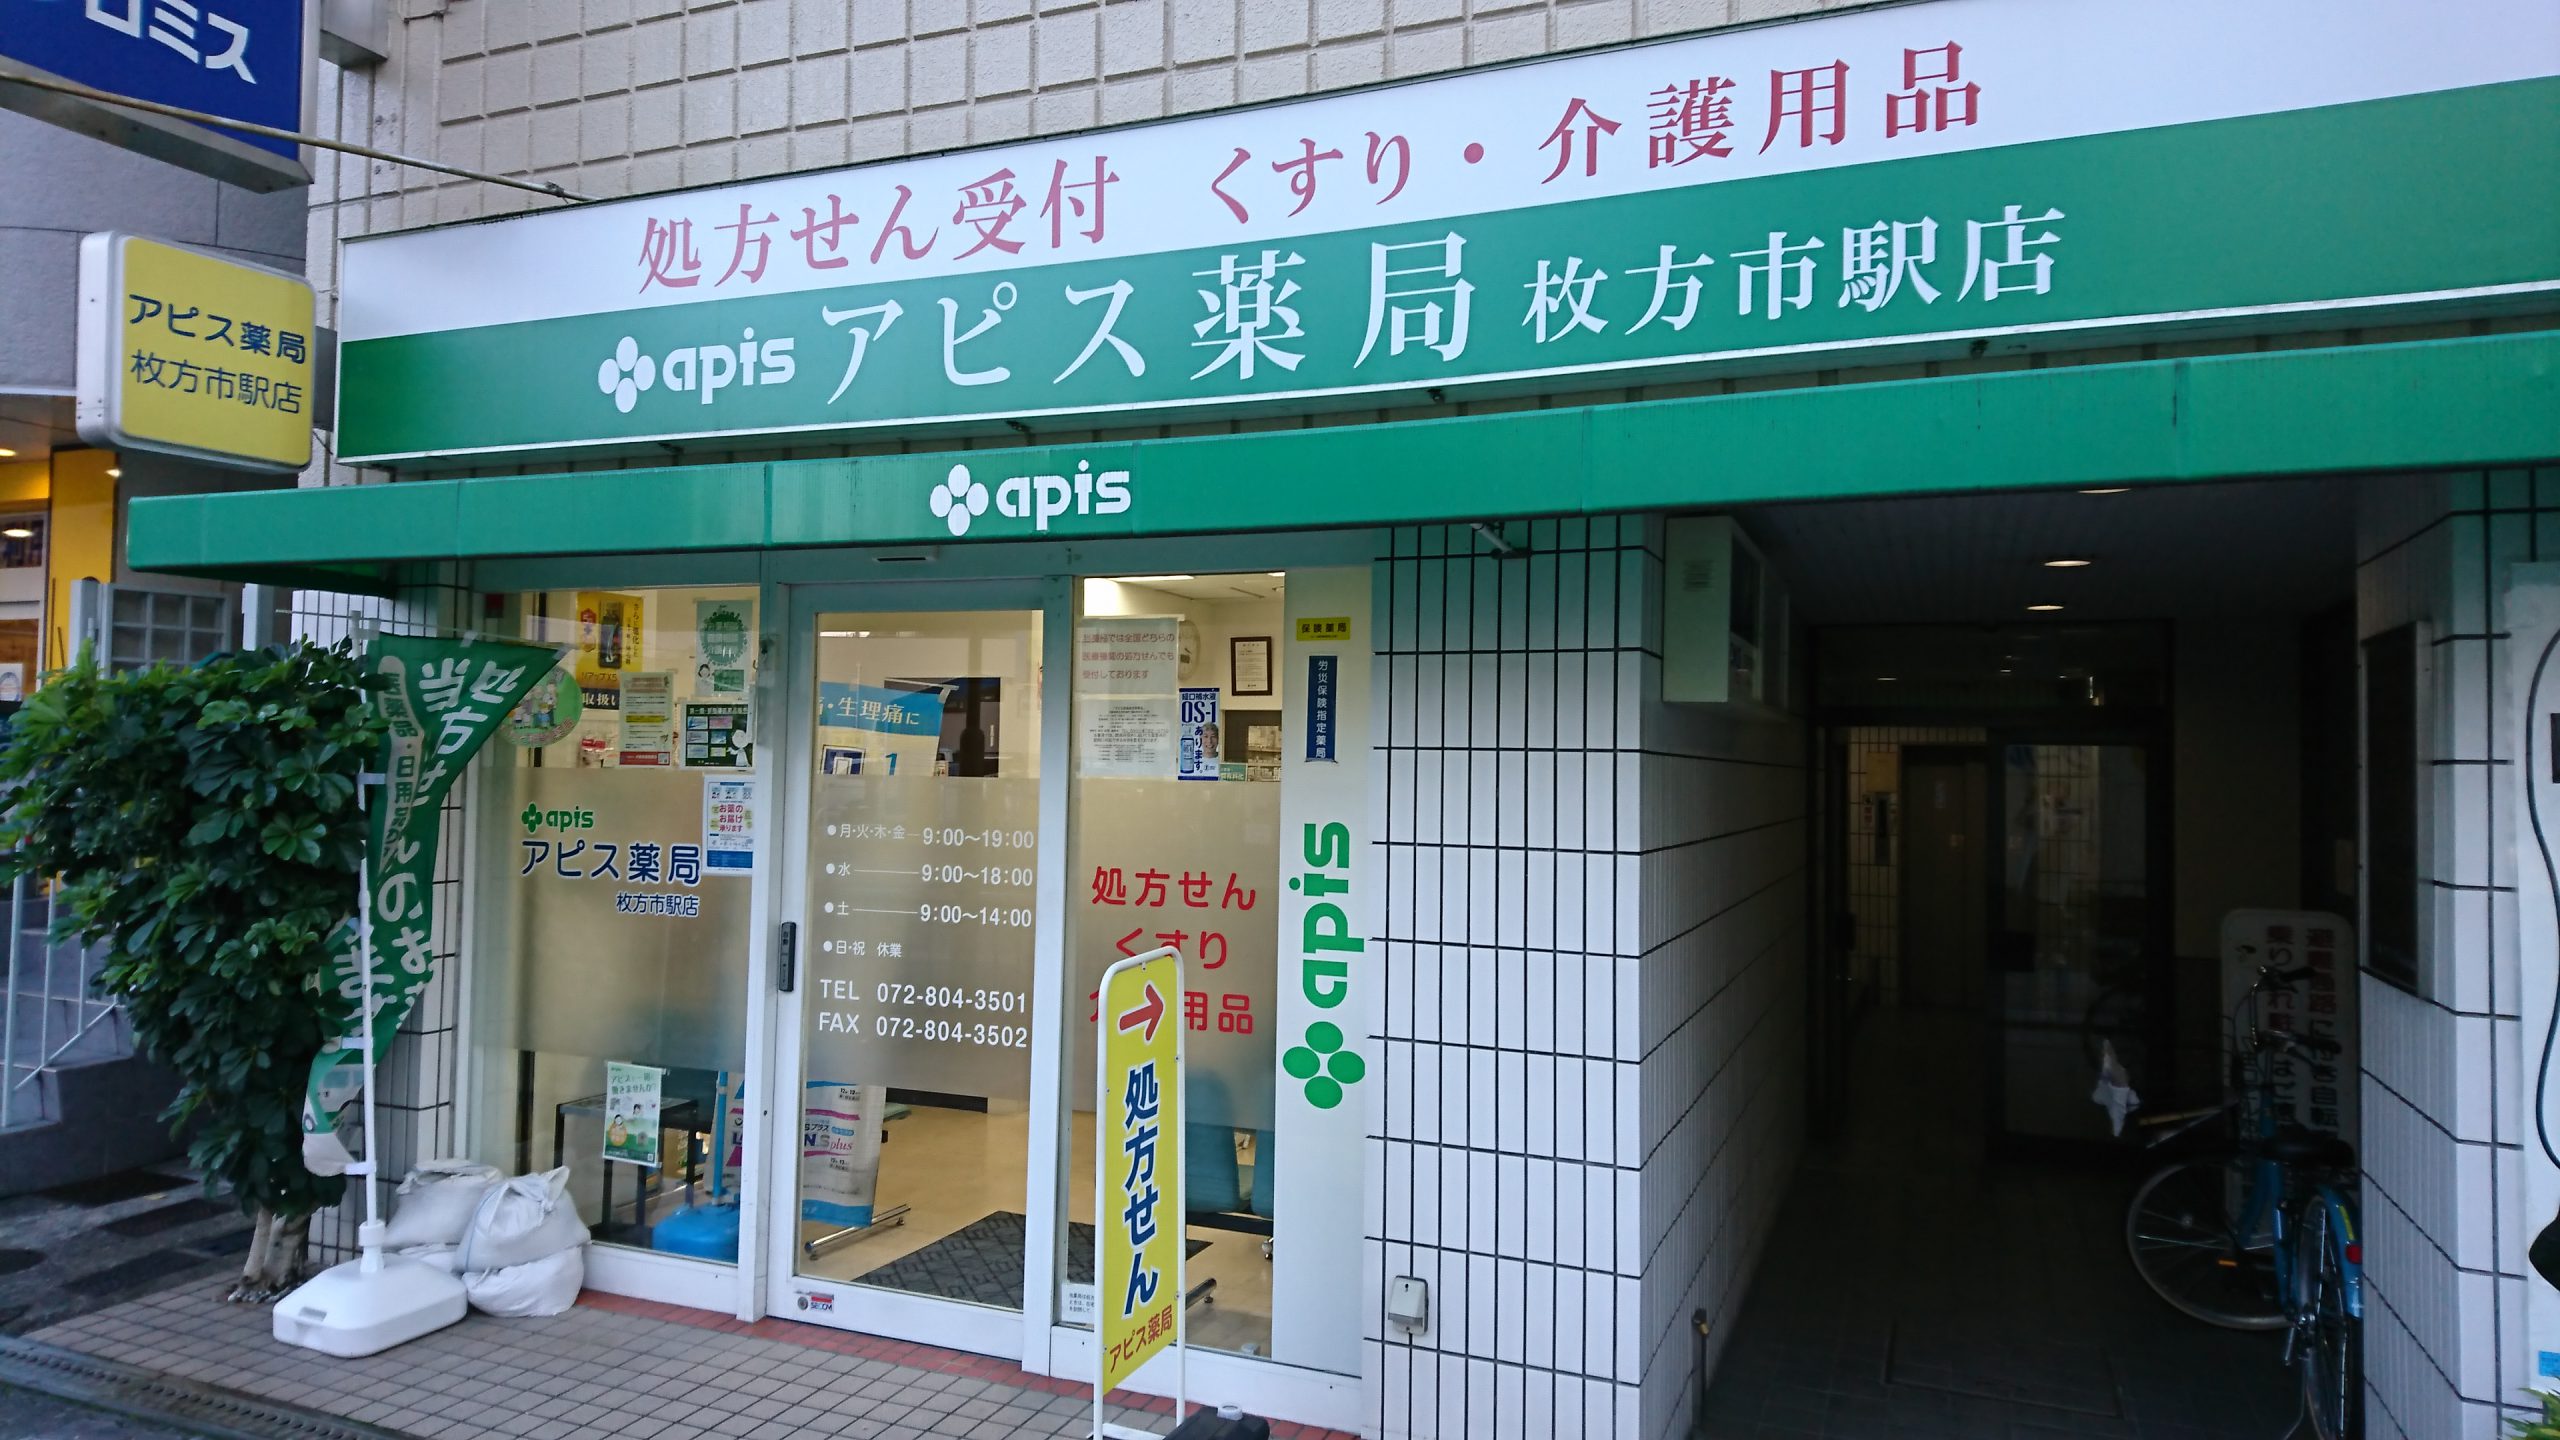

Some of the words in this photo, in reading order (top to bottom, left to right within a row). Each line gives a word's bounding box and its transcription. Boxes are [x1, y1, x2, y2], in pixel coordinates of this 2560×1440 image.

[638, 156, 1120, 294] 処方せん受付
[1210, 40, 1982, 226] くすり・介護用品
[129, 294, 306, 364] アピス薬局
[821, 230, 1476, 405] アピス薬局
[1520, 204, 2066, 345] 枚方市駅店
[130, 350, 303, 415] 枚方市駅店
[662, 327, 796, 405] apis
[995, 459, 1132, 531] apis
[1181, 700, 1217, 723] OS-1
[1315, 660, 1329, 759] 労災保険指定薬局
[545, 805, 594, 833] apis
[521, 838, 701, 886] アピス薬局
[1092, 866, 1256, 911] 処方せん
[615, 891, 700, 918] 枚方市駅店
[1289, 822, 1365, 1009] apis
[877, 942, 903, 958] 休業
[819, 1011, 860, 1035] FAX
[876, 1015, 1028, 1049] 072-804-3502
[820, 979, 860, 1001] TEL
[876, 983, 1027, 1014] 072-804-3501
[1121, 1062, 1159, 1318] 処方せん
[1109, 1304, 1173, 1373] アピス薬局
